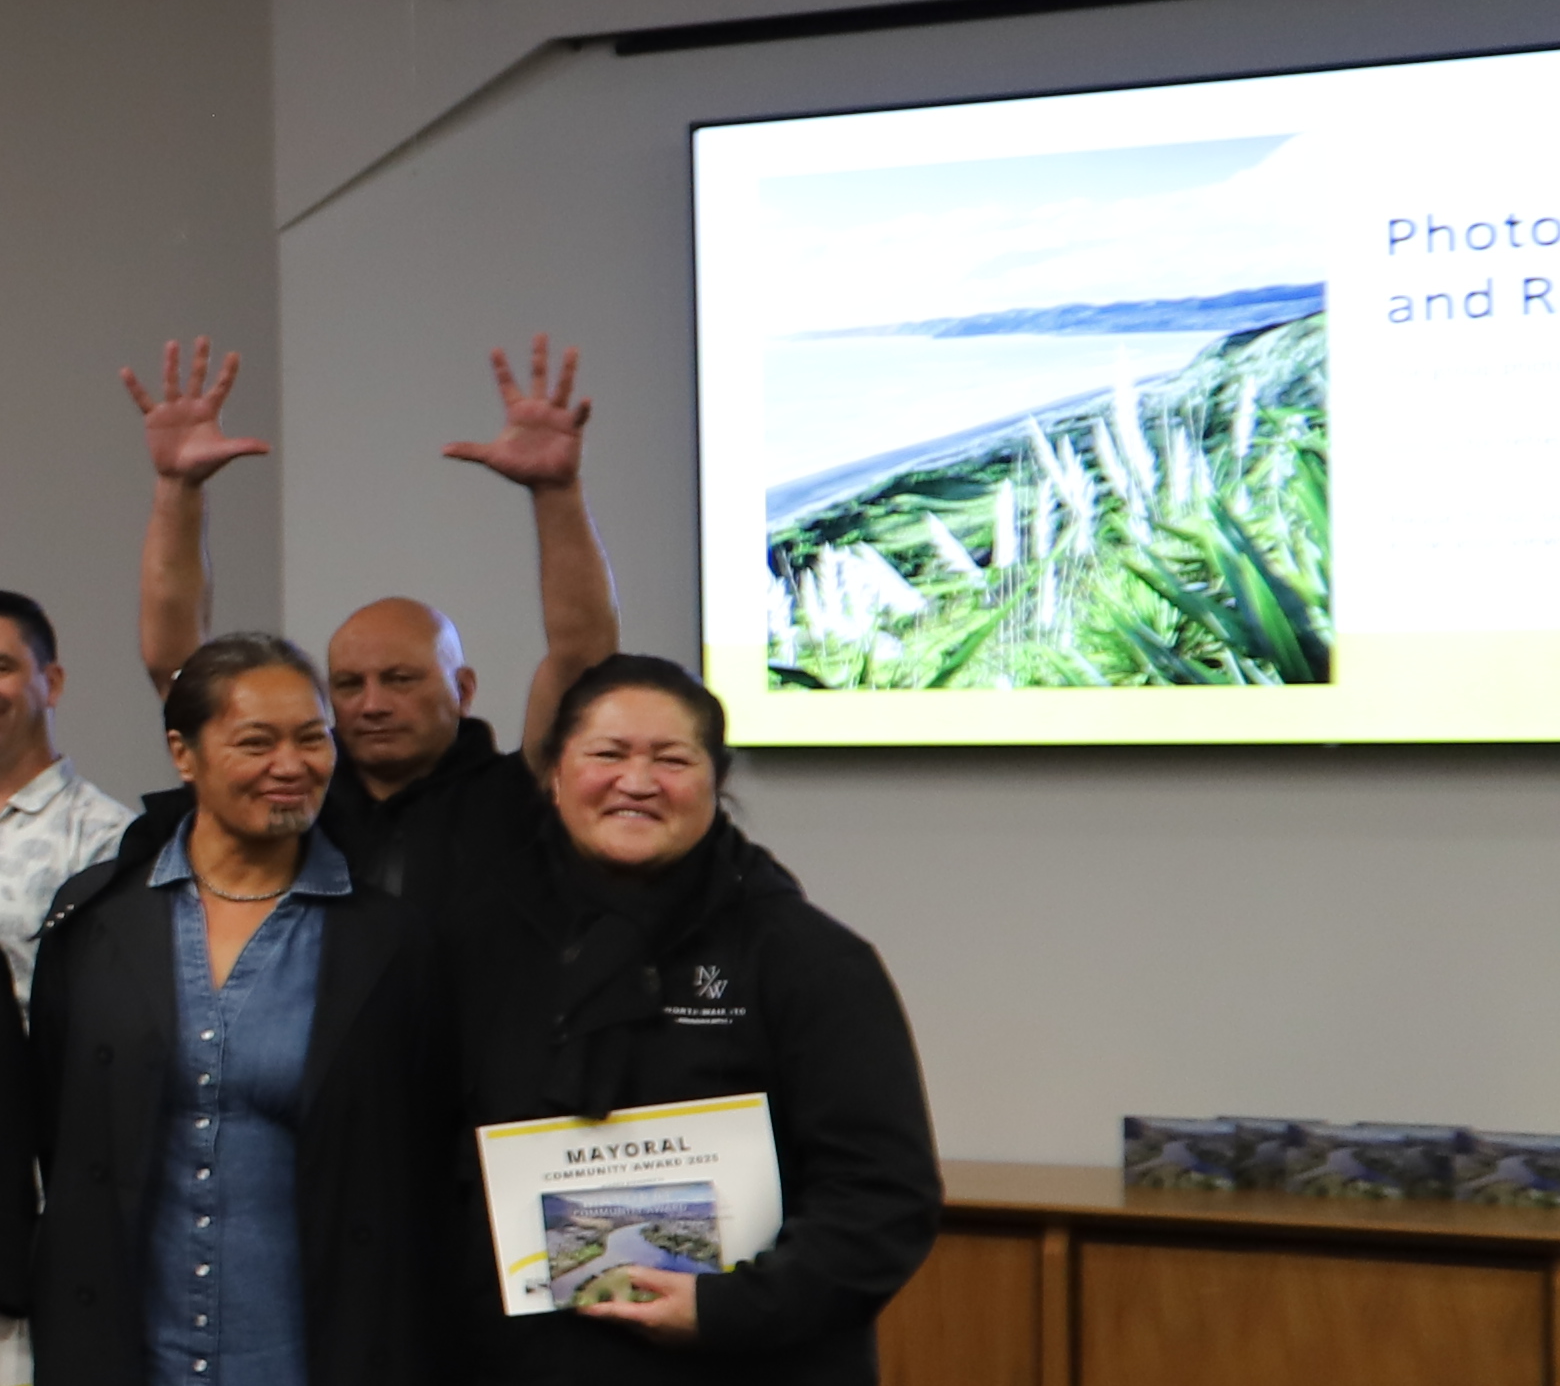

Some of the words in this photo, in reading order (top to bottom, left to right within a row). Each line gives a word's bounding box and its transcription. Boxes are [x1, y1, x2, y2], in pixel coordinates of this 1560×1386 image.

[1387, 213, 1560, 256] Photo
[1387, 277, 1494, 324] and
[566, 1135, 692, 1164] MAYORAL
[544, 1164, 628, 1181] COMMUNITY
[633, 1158, 682, 1172] AWARD
